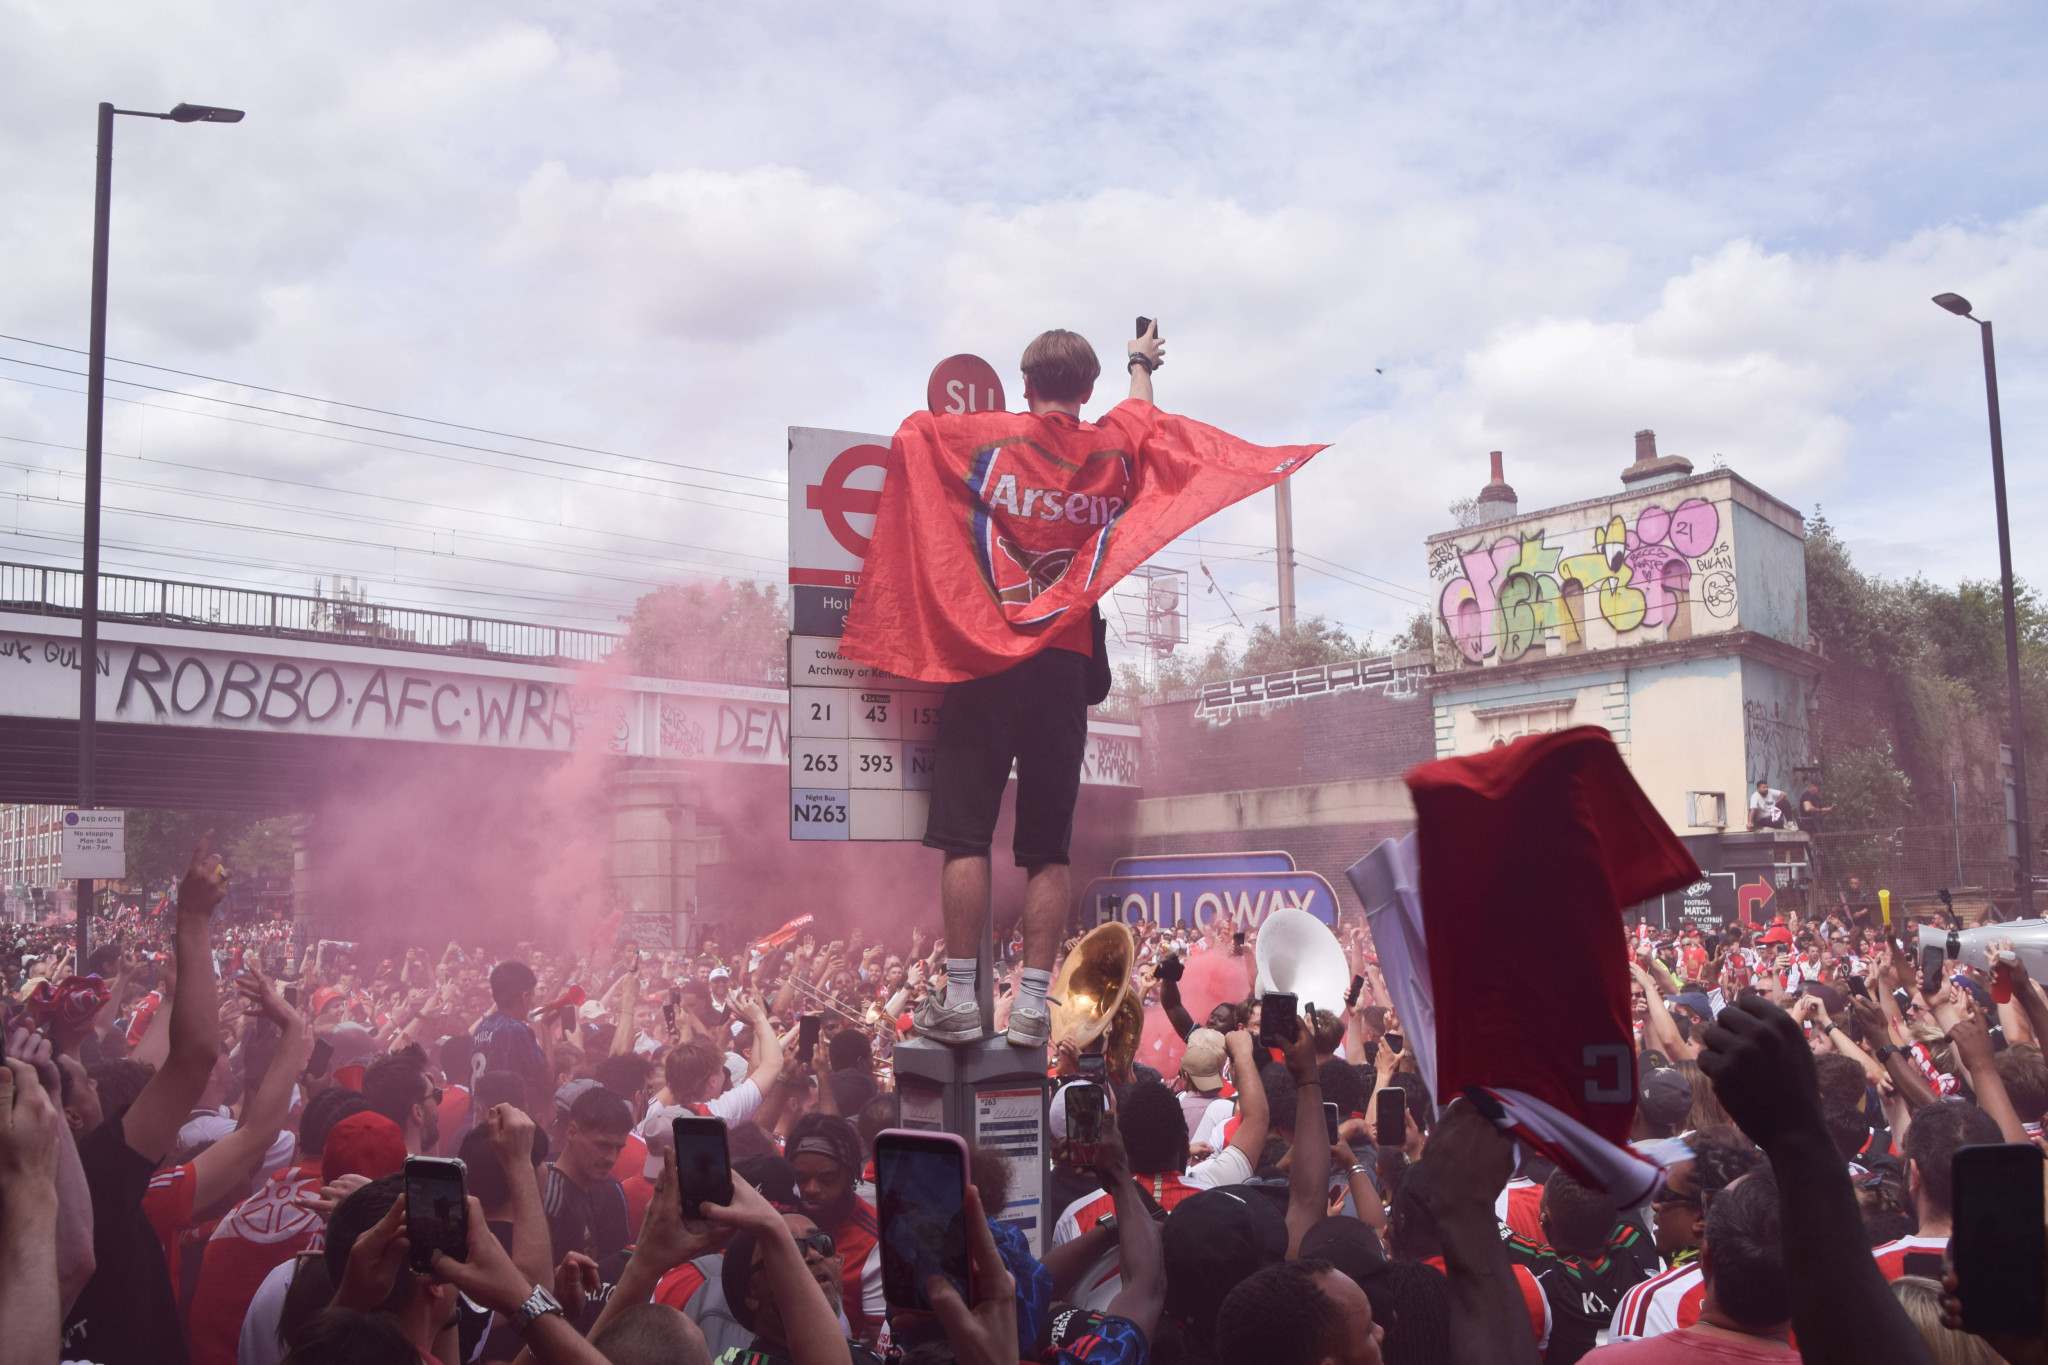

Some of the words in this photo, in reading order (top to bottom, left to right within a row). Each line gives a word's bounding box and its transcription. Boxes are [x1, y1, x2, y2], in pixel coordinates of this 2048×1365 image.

[989, 473, 1127, 526] Arsena
[844, 574, 861, 585] BU
[823, 596, 853, 611] Holl
[815, 649, 848, 661] towa
[807, 664, 855, 680] Archway
[858, 669, 869, 678] or
[810, 702, 831, 721] 21
[864, 705, 888, 723] 43
[913, 707, 940, 726] 153
[713, 704, 790, 757] DEN
[802, 753, 839, 773] 263
[859, 754, 894, 773] 393
[805, 794, 823, 802] Night
[793, 803, 847, 824] N263
[85, 830, 114, 838] stopping
[1684, 907, 1711, 915] MATCH
